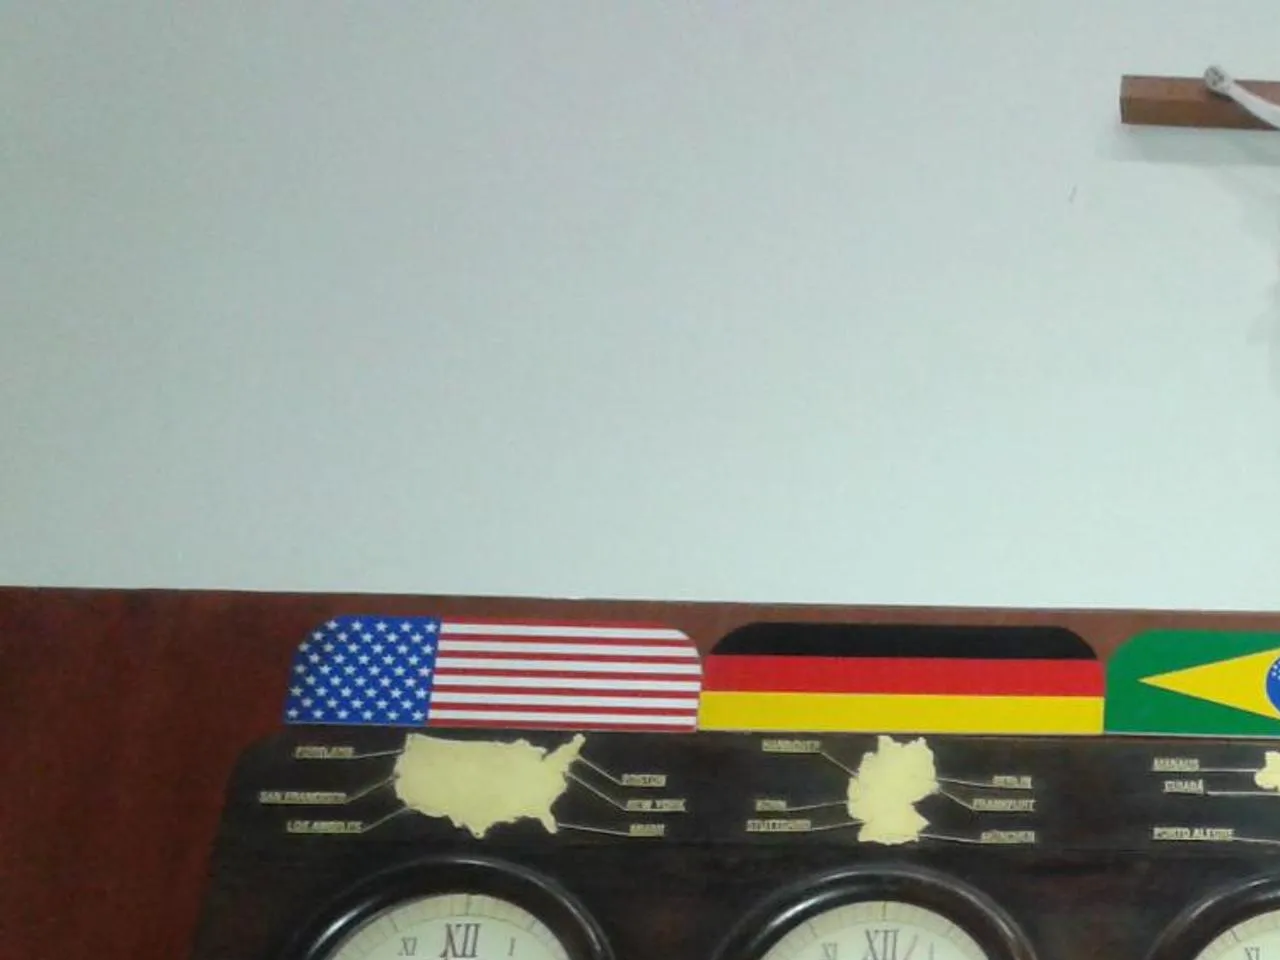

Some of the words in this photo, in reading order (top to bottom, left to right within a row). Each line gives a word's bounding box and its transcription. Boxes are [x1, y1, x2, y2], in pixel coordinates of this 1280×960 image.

[397, 937, 418, 956] XI
[440, 923, 481, 958] XII
[508, 937, 516, 957] I
